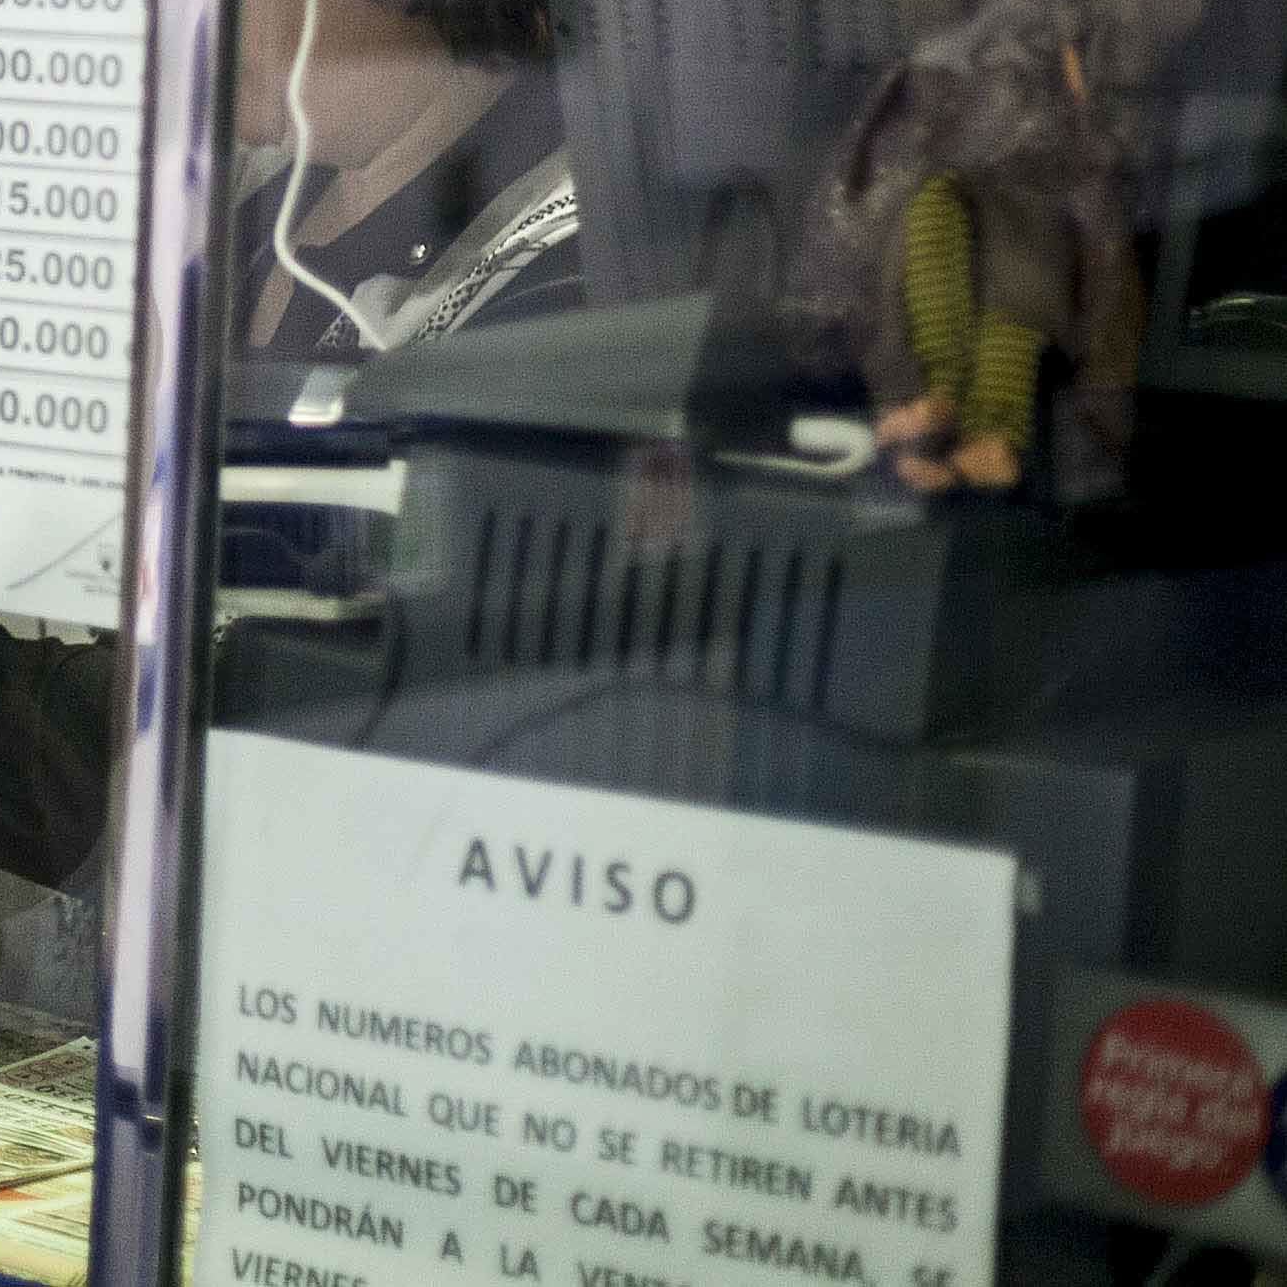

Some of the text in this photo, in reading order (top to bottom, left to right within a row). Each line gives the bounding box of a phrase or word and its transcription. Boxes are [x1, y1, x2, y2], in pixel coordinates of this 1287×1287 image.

[458, 836, 698, 925] AVISO
[238, 982, 962, 1157] LOS NUMEROS ABONADOS DE LOTERIA
[234, 1117, 293, 1161] DEL
[320, 1134, 463, 1198] VIERNES
[493, 1171, 538, 1214] DE
[570, 1188, 670, 1243] CADA
[236, 1048, 960, 1234] NACIONAL QUE NO SE RETIREN ANTES
[237, 1180, 541, 1283] PONDRÁN A LA
